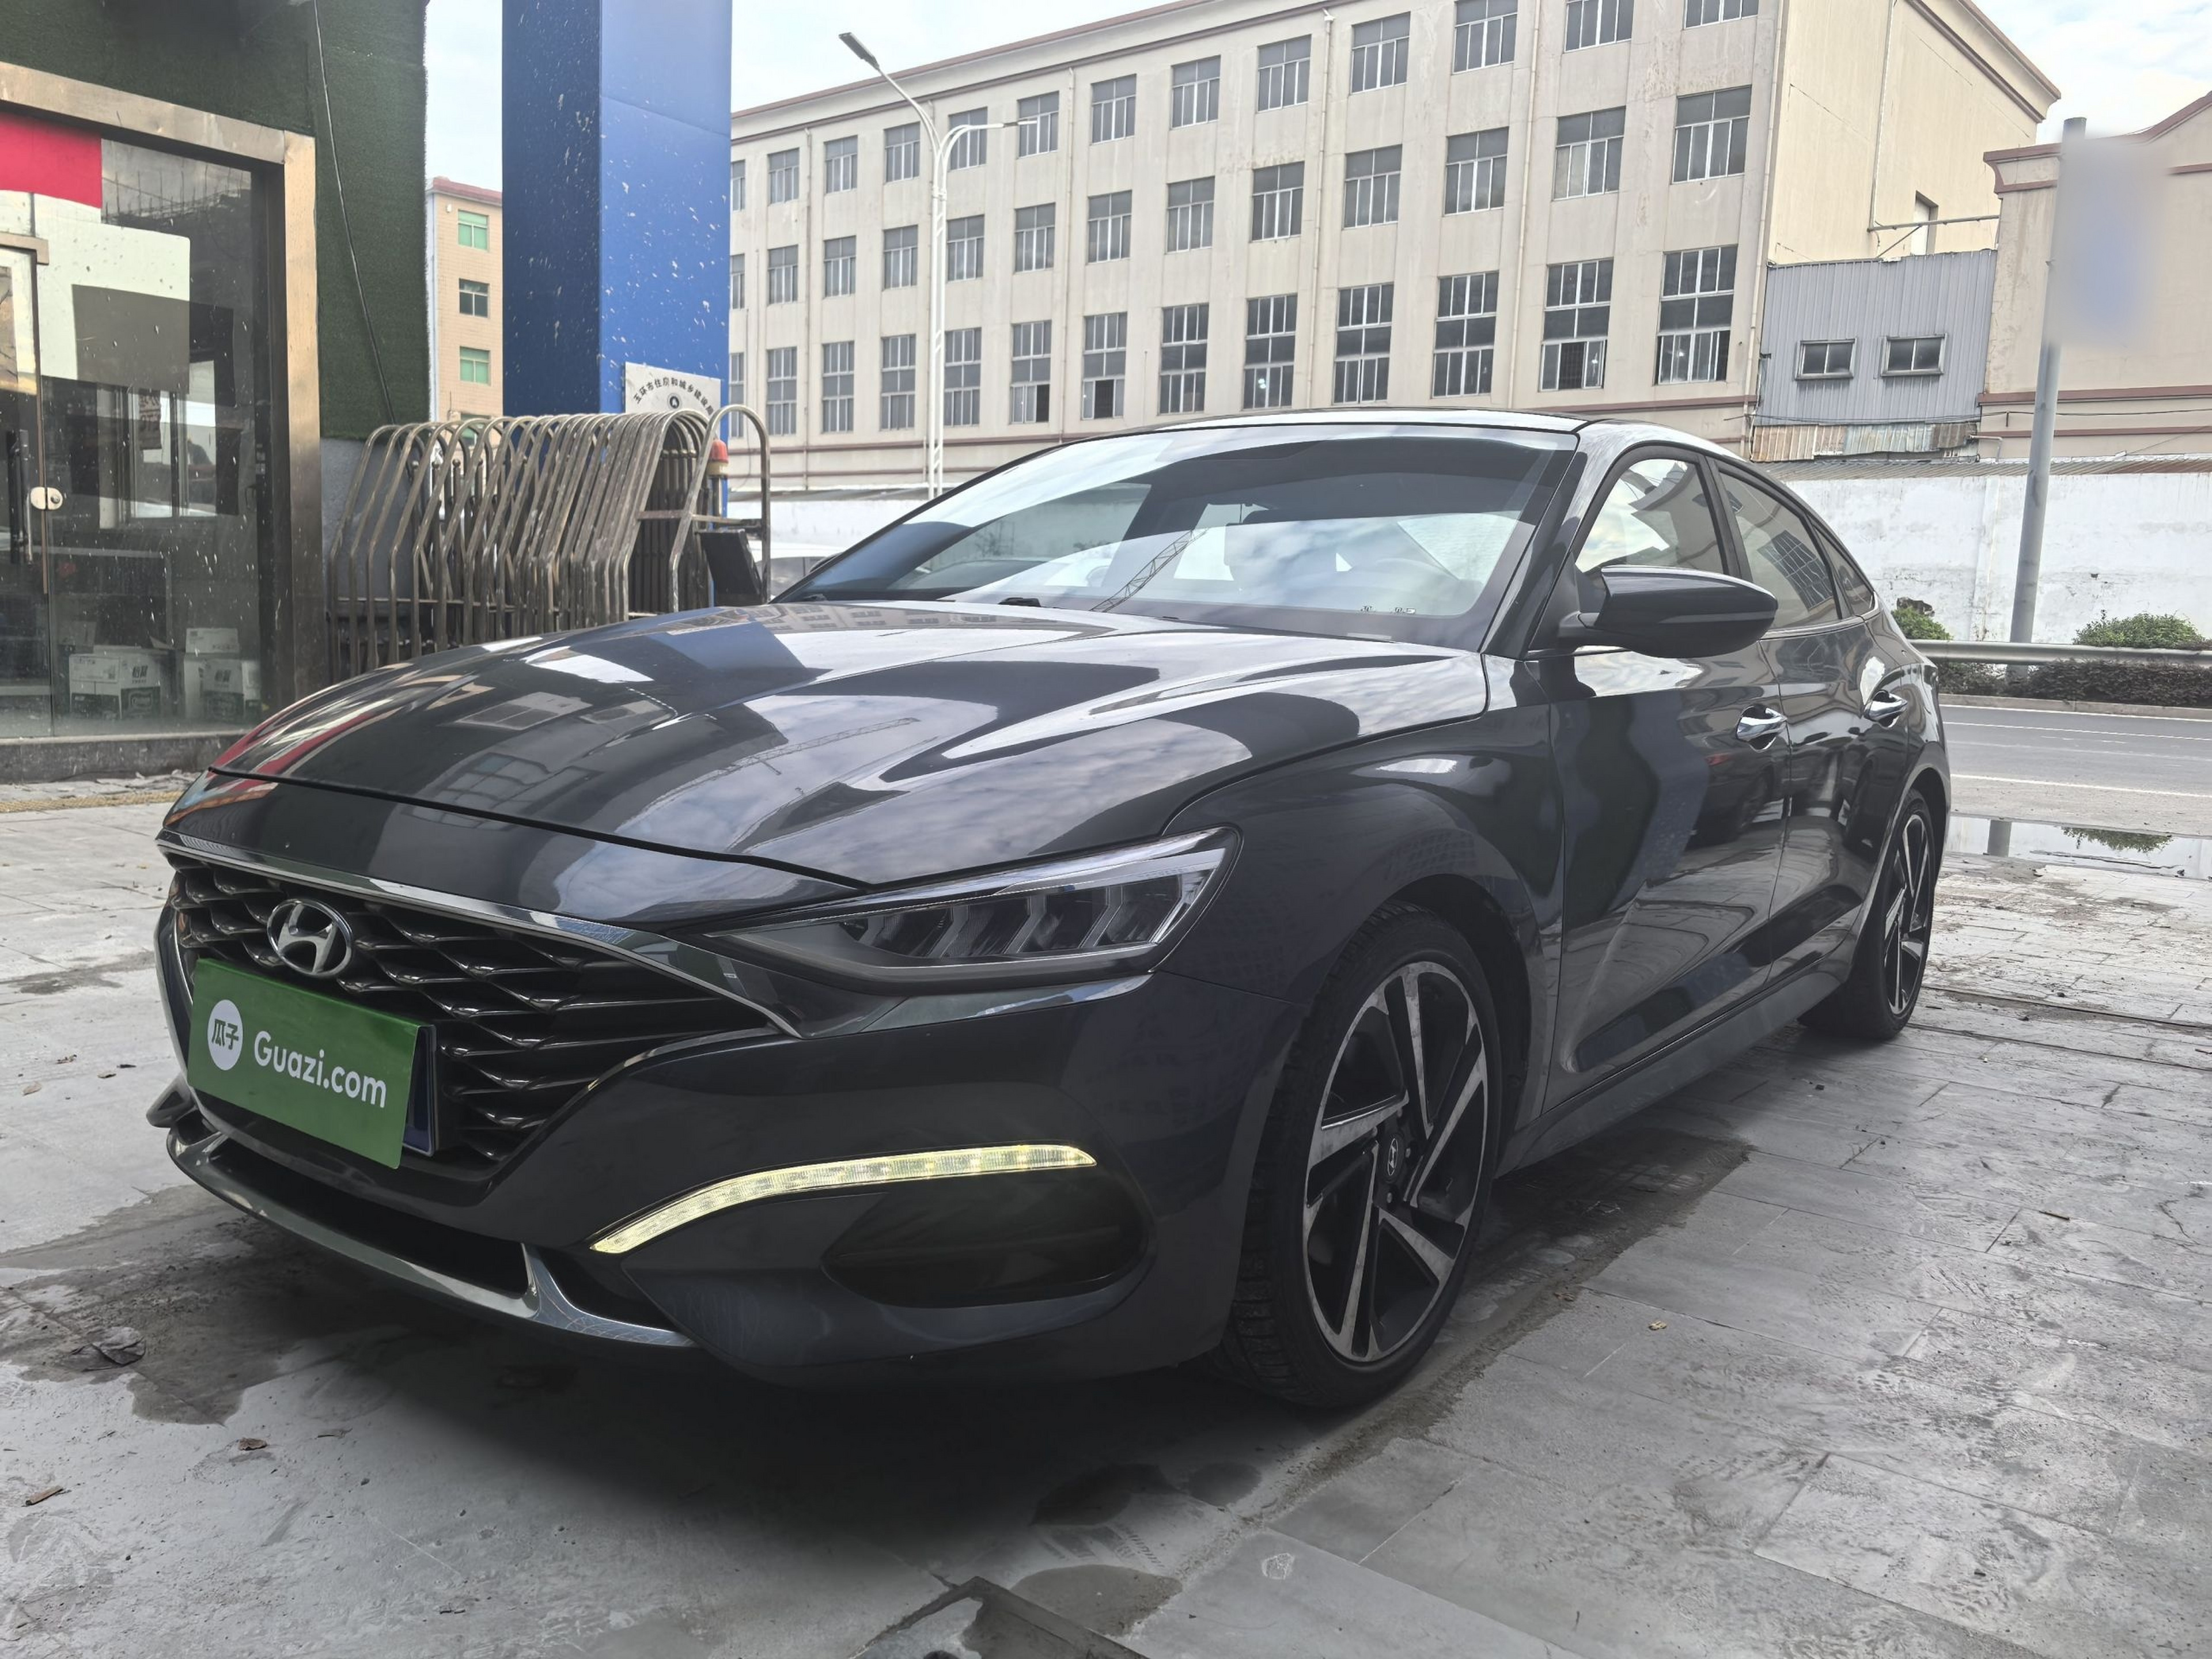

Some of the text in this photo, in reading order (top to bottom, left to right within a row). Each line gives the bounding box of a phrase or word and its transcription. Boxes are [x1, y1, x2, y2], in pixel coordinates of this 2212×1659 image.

[633, 377, 714, 415] 玉环市住房和城乡建设局
[211, 1018, 240, 1051] 瓜子
[253, 1030, 387, 1108] Guazi.com
